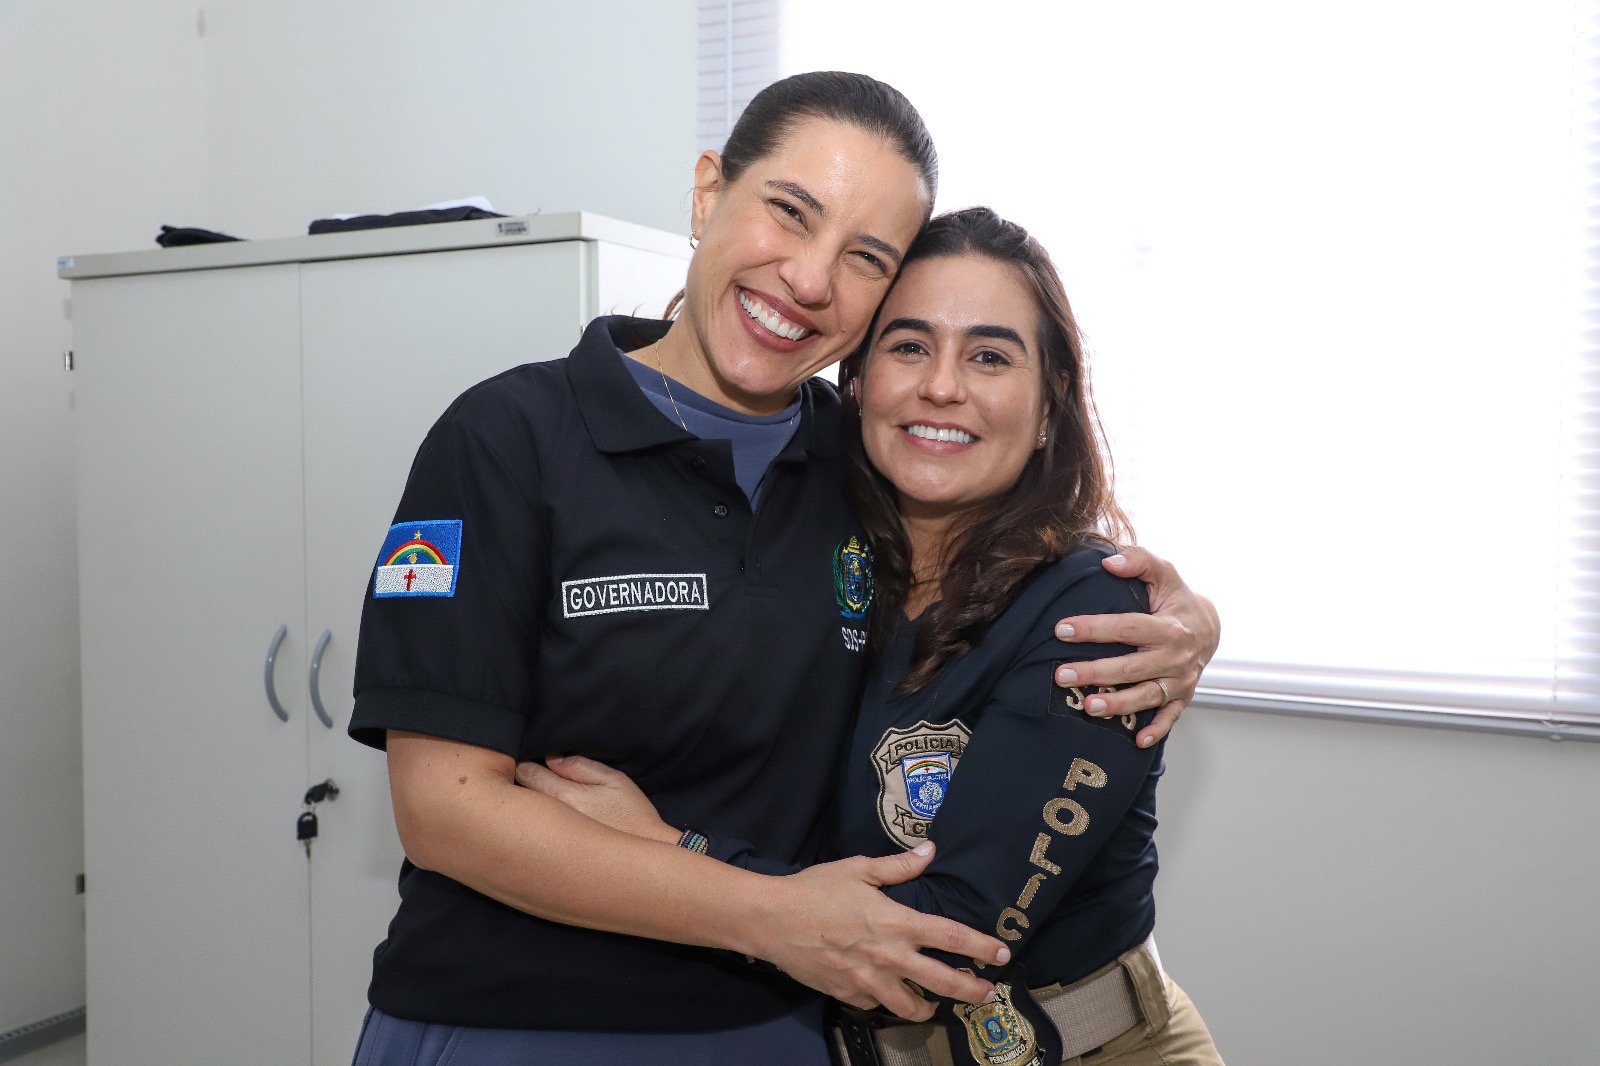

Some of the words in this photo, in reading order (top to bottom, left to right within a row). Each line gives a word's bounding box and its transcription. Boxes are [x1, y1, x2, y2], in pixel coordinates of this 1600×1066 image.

[570, 580, 702, 610] GOVERNADORA
[894, 735, 955, 756] POLÍCIA
[974, 757, 1109, 969] POLÍC
[988, 1043, 1026, 1065] PERNAMBUCO
